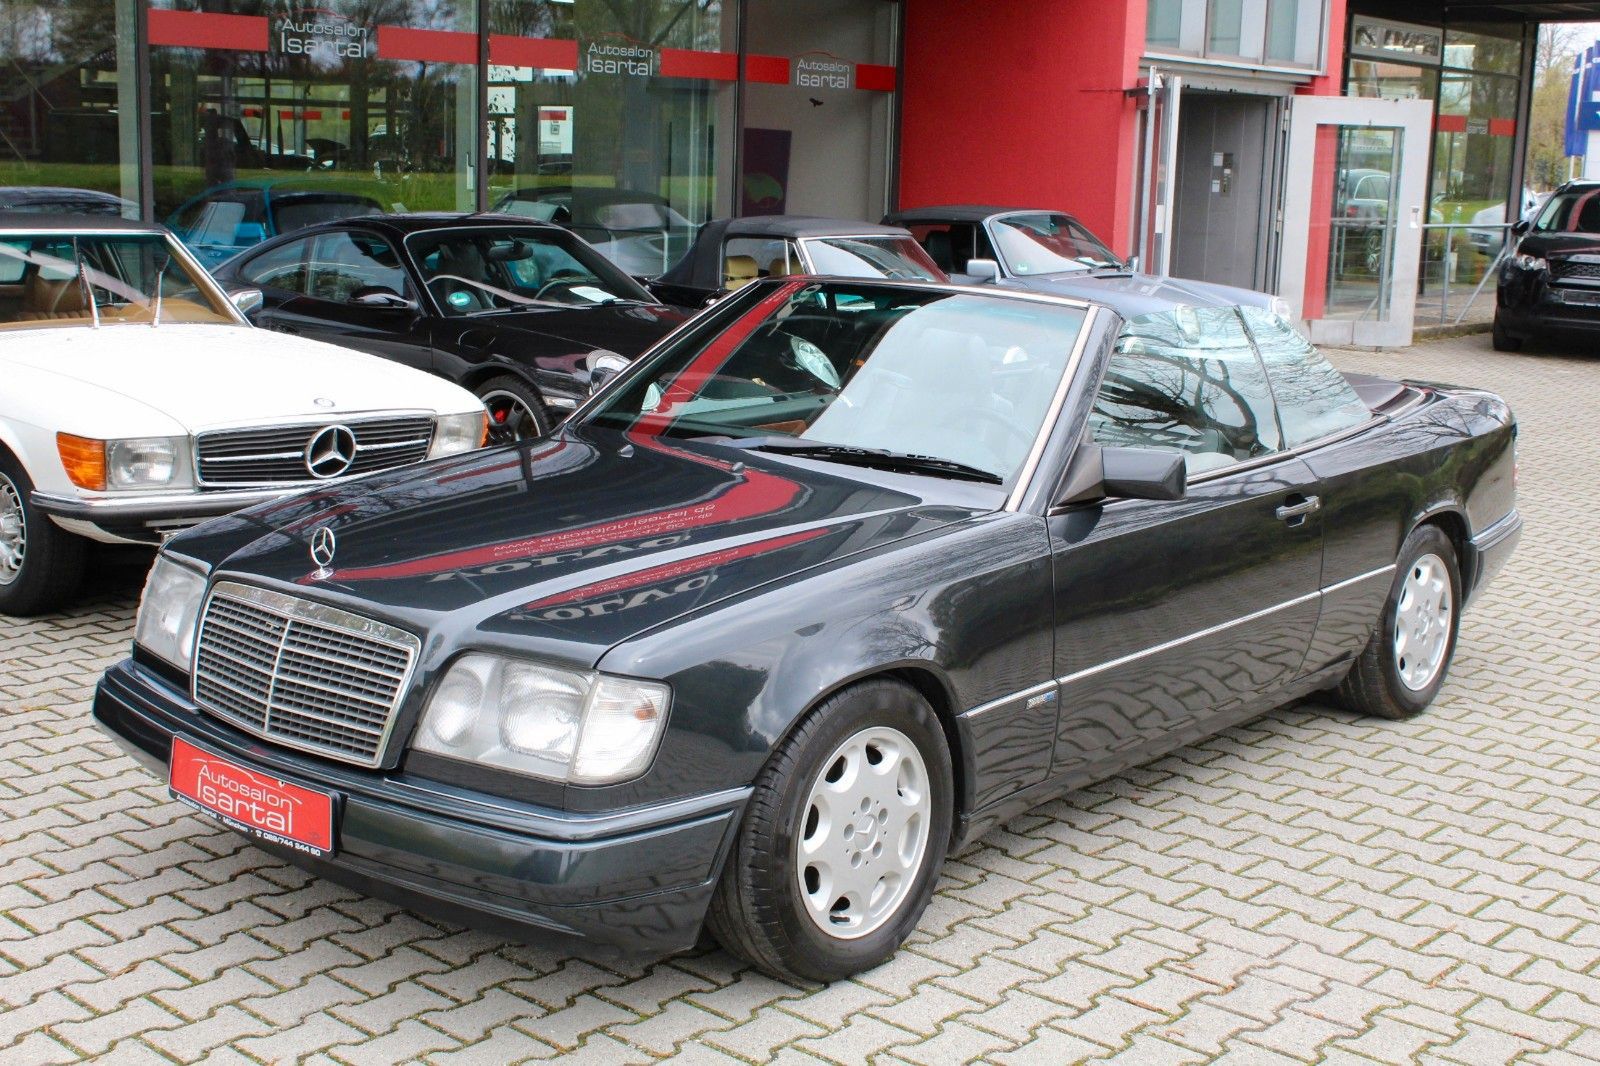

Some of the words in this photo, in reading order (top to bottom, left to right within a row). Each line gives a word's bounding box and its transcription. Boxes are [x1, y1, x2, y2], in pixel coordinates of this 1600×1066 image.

[281, 18, 367, 37] Autosalon
[281, 32, 367, 58] Isartal
[587, 42, 653, 58] Autosalon
[587, 54, 653, 76] Isartal
[797, 59, 850, 72] Autosalon
[797, 69, 850, 88] Isartal
[199, 764, 293, 812] Autosalon
[197, 776, 293, 834] Isartal
